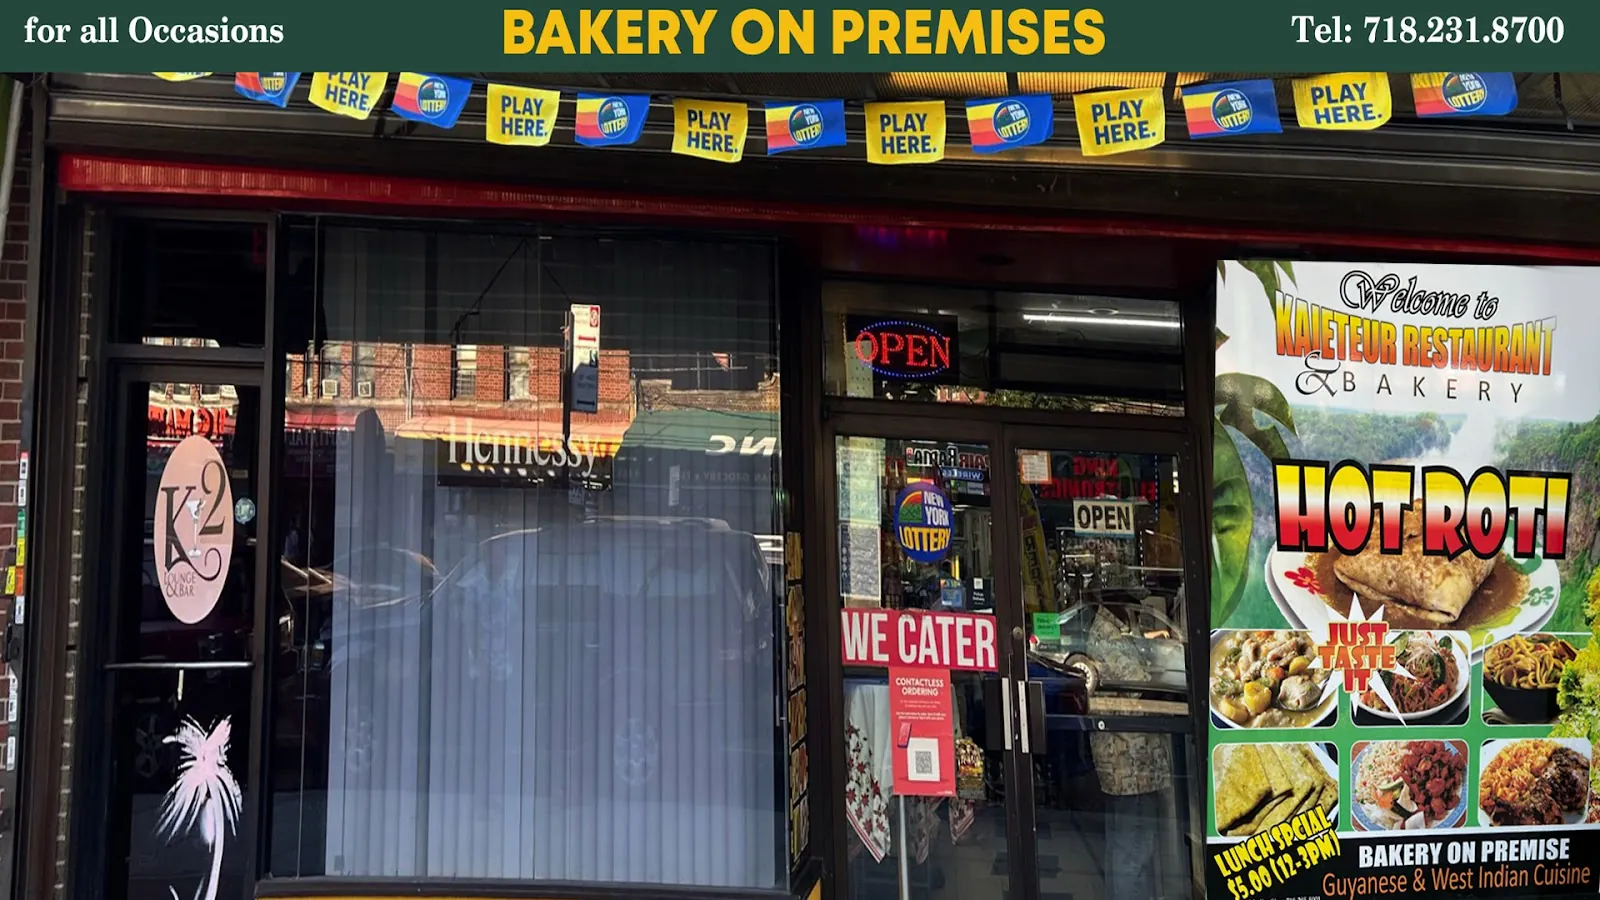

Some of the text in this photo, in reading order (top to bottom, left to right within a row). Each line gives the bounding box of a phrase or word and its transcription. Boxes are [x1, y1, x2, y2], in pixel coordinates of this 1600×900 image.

[325, 84, 371, 112] HERE.
[501, 95, 544, 117] PLAY
[1230, 100, 1248, 112] YORK
[1310, 82, 1368, 106] PLAY
[687, 109, 732, 131] PLAY
[879, 112, 928, 133] PLAY
[1091, 99, 1144, 124] PLAY
[1313, 103, 1383, 125] HERE.
[501, 117, 549, 138] HERE.
[1094, 120, 1157, 146] HERE.
[687, 131, 739, 154] HERE.
[881, 134, 938, 155] HERE.
[1339, 270, 1500, 320] Welcome to
[1275, 289, 1557, 376] KAIETEUR RESTAURANT
[854, 331, 951, 368] OPEN
[1295, 351, 1523, 403] & BAKERY
[448, 415, 597, 478] Hennessy
[924, 491, 944, 507] NEW
[1272, 459, 1572, 561] HOT ROTI
[925, 506, 950, 526] YORK
[1077, 504, 1131, 530] OPEN
[899, 526, 951, 551] LOTTERY
[164, 571, 196, 585] LOUNGE
[841, 611, 996, 668] WE CATER
[1326, 621, 1389, 646] JUST
[1317, 645, 1396, 669] TASTE
[895, 677, 944, 688] CONTACTLESS
[901, 687, 938, 697] ORDERING
[1343, 668, 1372, 692] IT
[1214, 805, 1333, 877] LUNCH SPCIAL
[1359, 838, 1570, 869] BAKERY ON PREMISE
[1227, 828, 1341, 900] $5.00 (12-3PM)
[1322, 863, 1591, 897] Guyanese & West Indian Cuisine
